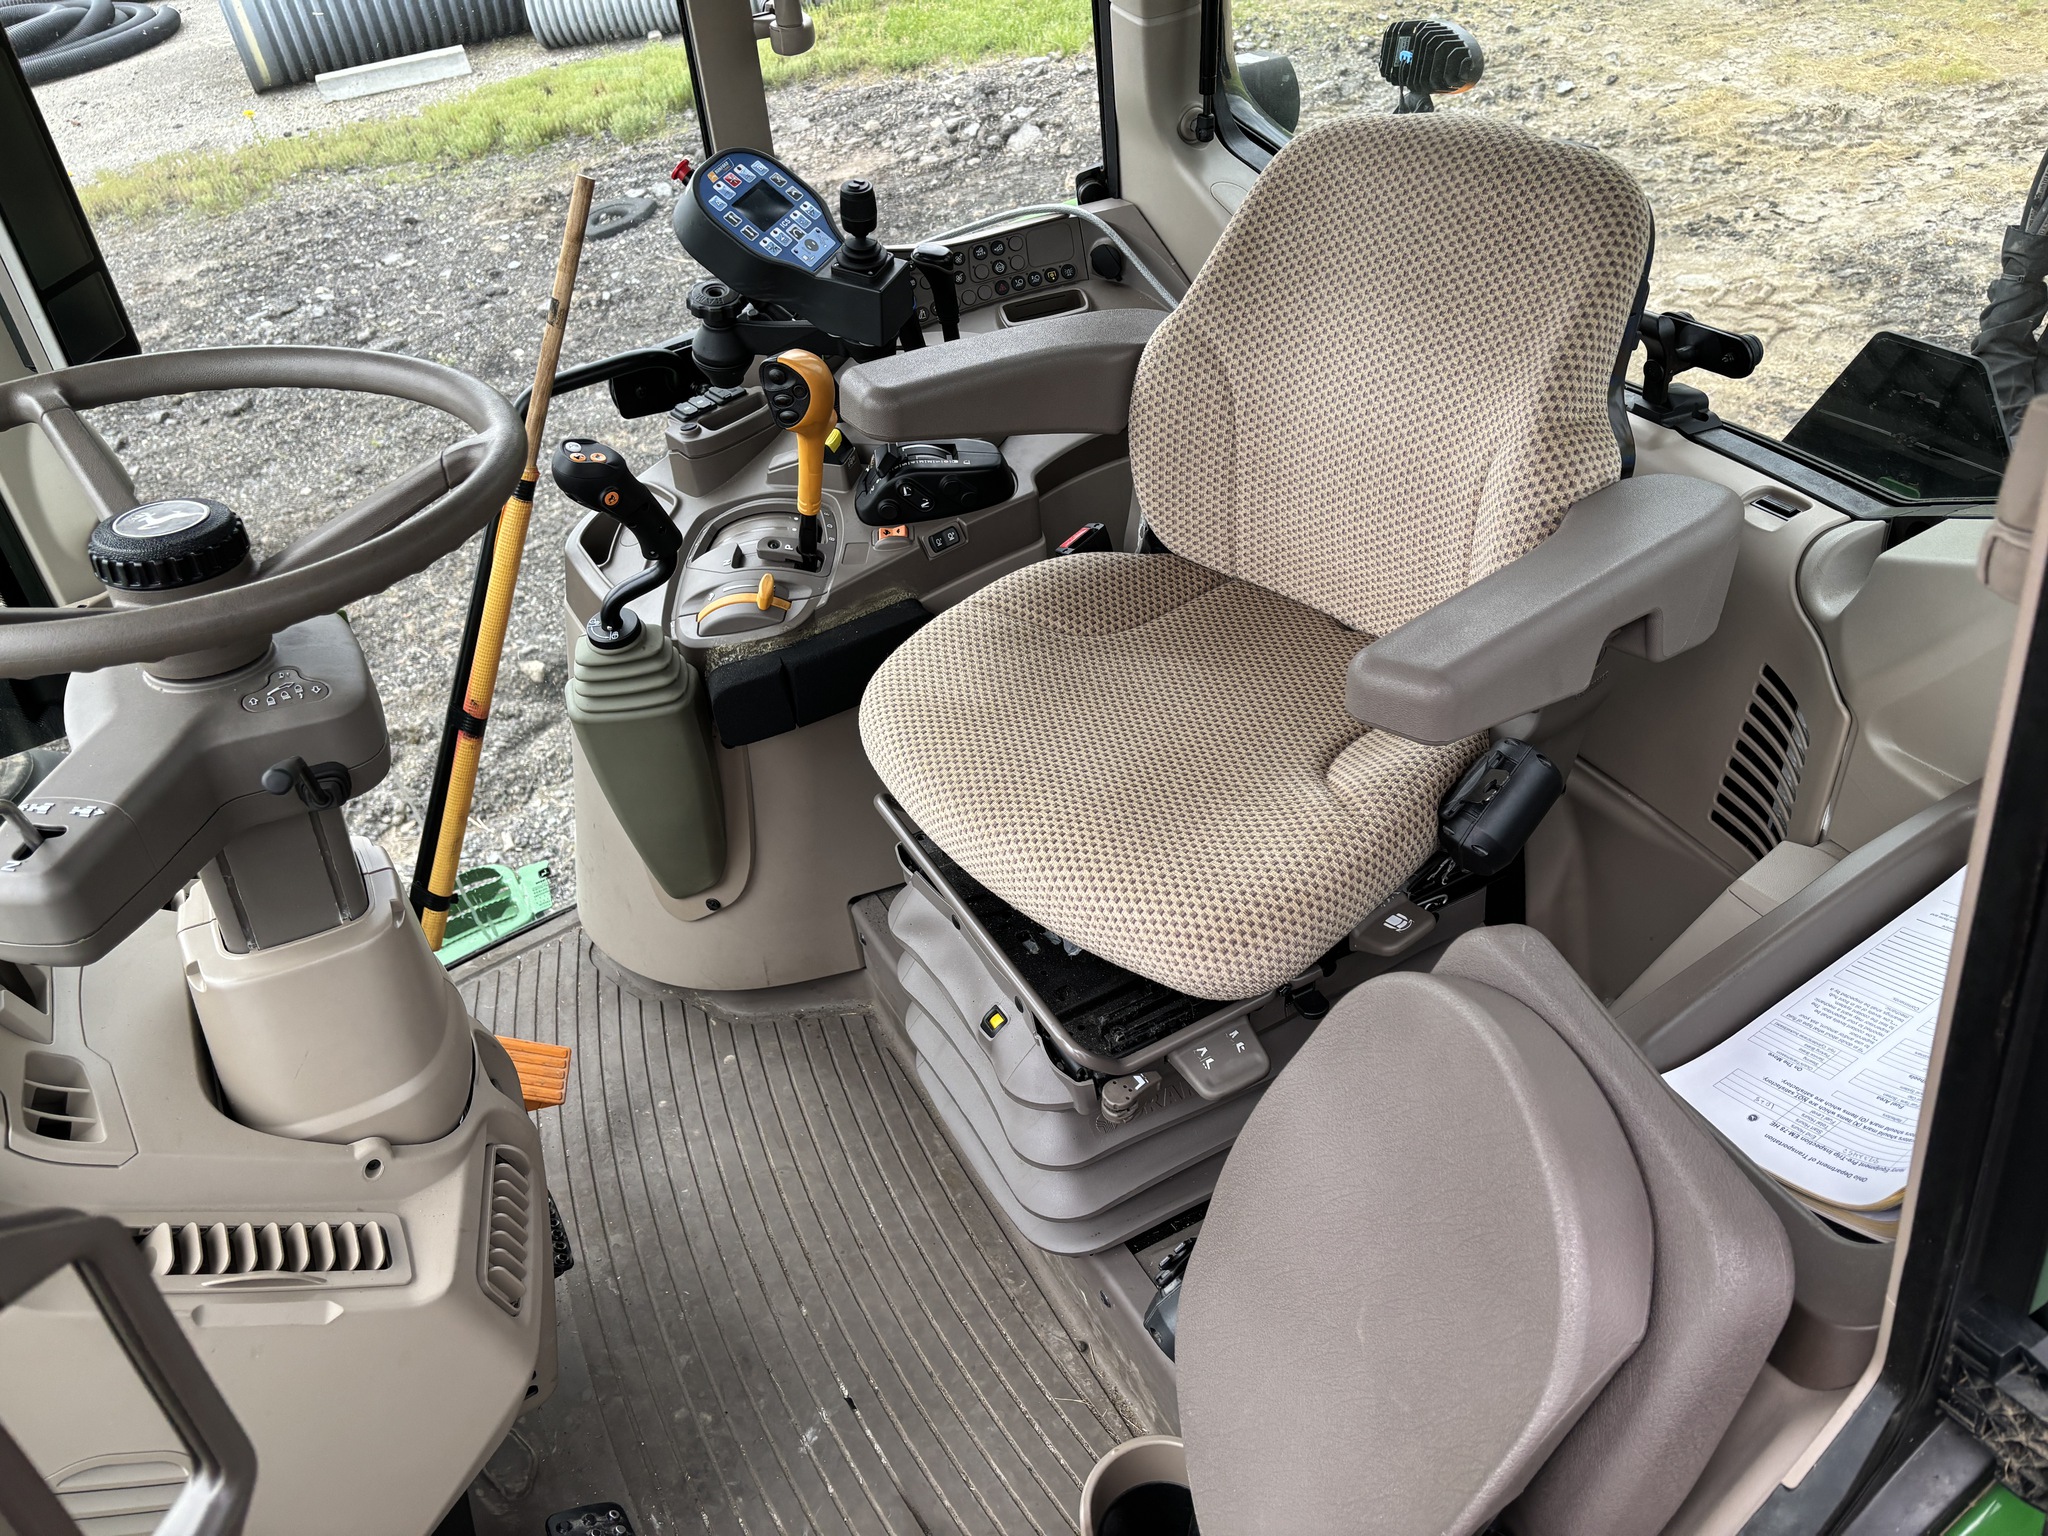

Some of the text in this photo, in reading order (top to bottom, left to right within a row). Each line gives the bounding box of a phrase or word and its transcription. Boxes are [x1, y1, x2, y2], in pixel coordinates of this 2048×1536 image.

[780, 218, 791, 228] ICS
[1768, 1051, 1782, 1061] Move
[1783, 1059, 1793, 1067] The
[1794, 1091, 1808, 1102] NOT
[1814, 1095, 1824, 1103] are
[1876, 1095, 1890, 1104] Area
[1807, 1099, 1818, 1107] are
[1824, 1100, 1842, 1111] which
[1810, 1109, 1824, 1118] Level
[1818, 1104, 1836, 1116] which
[1842, 1108, 1859, 1119] items
[1801, 1112, 1816, 1123] Hours
[1836, 1113, 1853, 1123] items
[1795, 1118, 1810, 1128] Hours
[1868, 1120, 1883, 1129] mark
[1790, 1124, 1805, 1134] Hours
[1862, 1124, 1877, 1133] mark
[1764, 1133, 1808, 1159] Transportation
[1800, 1136, 1833, 1155] Inspection
[1832, 1150, 1859, 1165] Pre-Trip
[1816, 1159, 1853, 1178] Department
